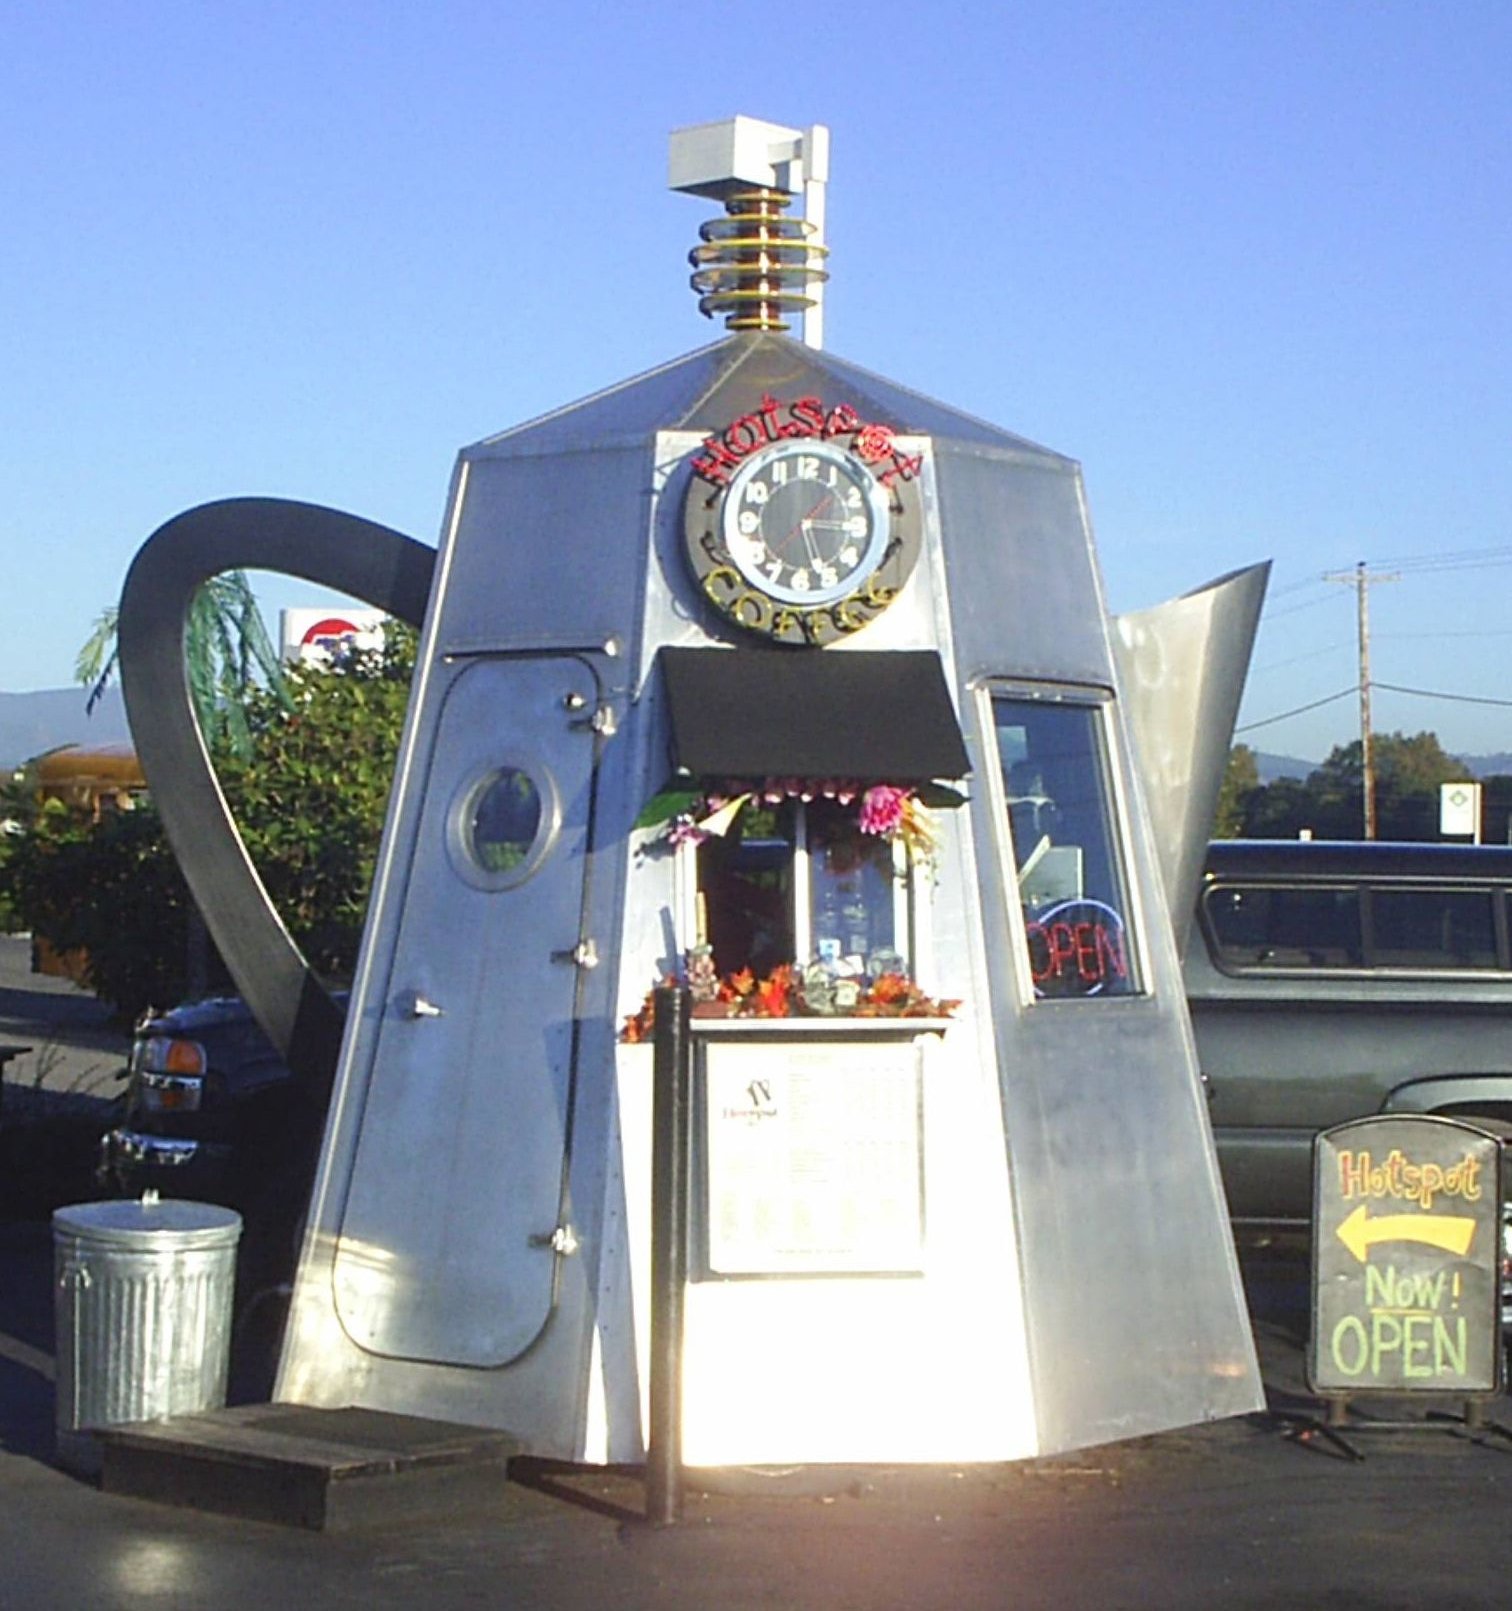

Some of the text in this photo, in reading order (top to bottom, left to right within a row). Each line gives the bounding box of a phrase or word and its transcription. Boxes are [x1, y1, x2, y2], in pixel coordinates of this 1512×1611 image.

[772, 461, 787, 485] 11
[797, 456, 820, 479] 12
[827, 466, 837, 487] 1
[746, 481, 768, 504] 10
[848, 486, 862, 508] 2
[739, 511, 760, 534] 9
[840, 547, 858, 568] 4
[766, 559, 782, 584] 7
[791, 568, 810, 591] 6
[820, 567, 838, 588] 5
[703, 566, 902, 638] COFFEE
[1025, 921, 1128, 981] OPEN
[1337, 1150, 1482, 1209] Hotspot
[1332, 1315, 1467, 1378] OPEN
